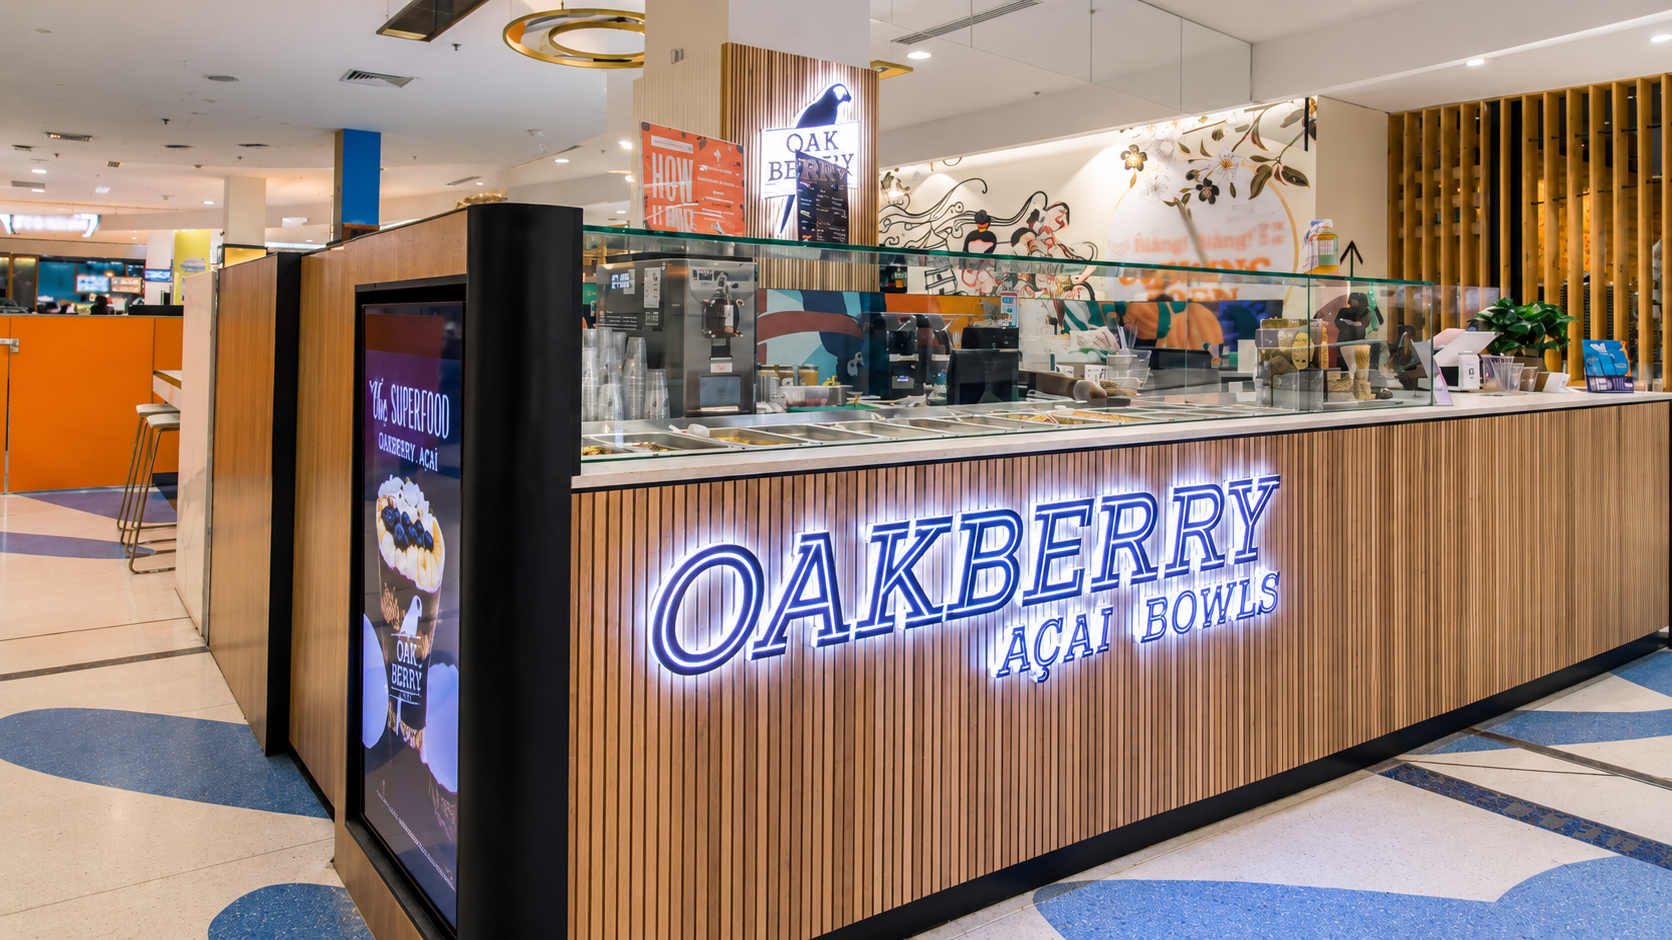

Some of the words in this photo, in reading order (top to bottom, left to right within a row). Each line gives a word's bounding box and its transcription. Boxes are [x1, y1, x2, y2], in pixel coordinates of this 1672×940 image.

[786, 130, 839, 153] OAK
[651, 152, 694, 203] HOW
[768, 153, 854, 181] BEY
[391, 384, 450, 439] SUPERFOOD
[652, 474, 1281, 676] OAKBERRY
[1141, 570, 1280, 643] BOWLS
[397, 640, 421, 668] OAK
[392, 662, 422, 692] BERRY
